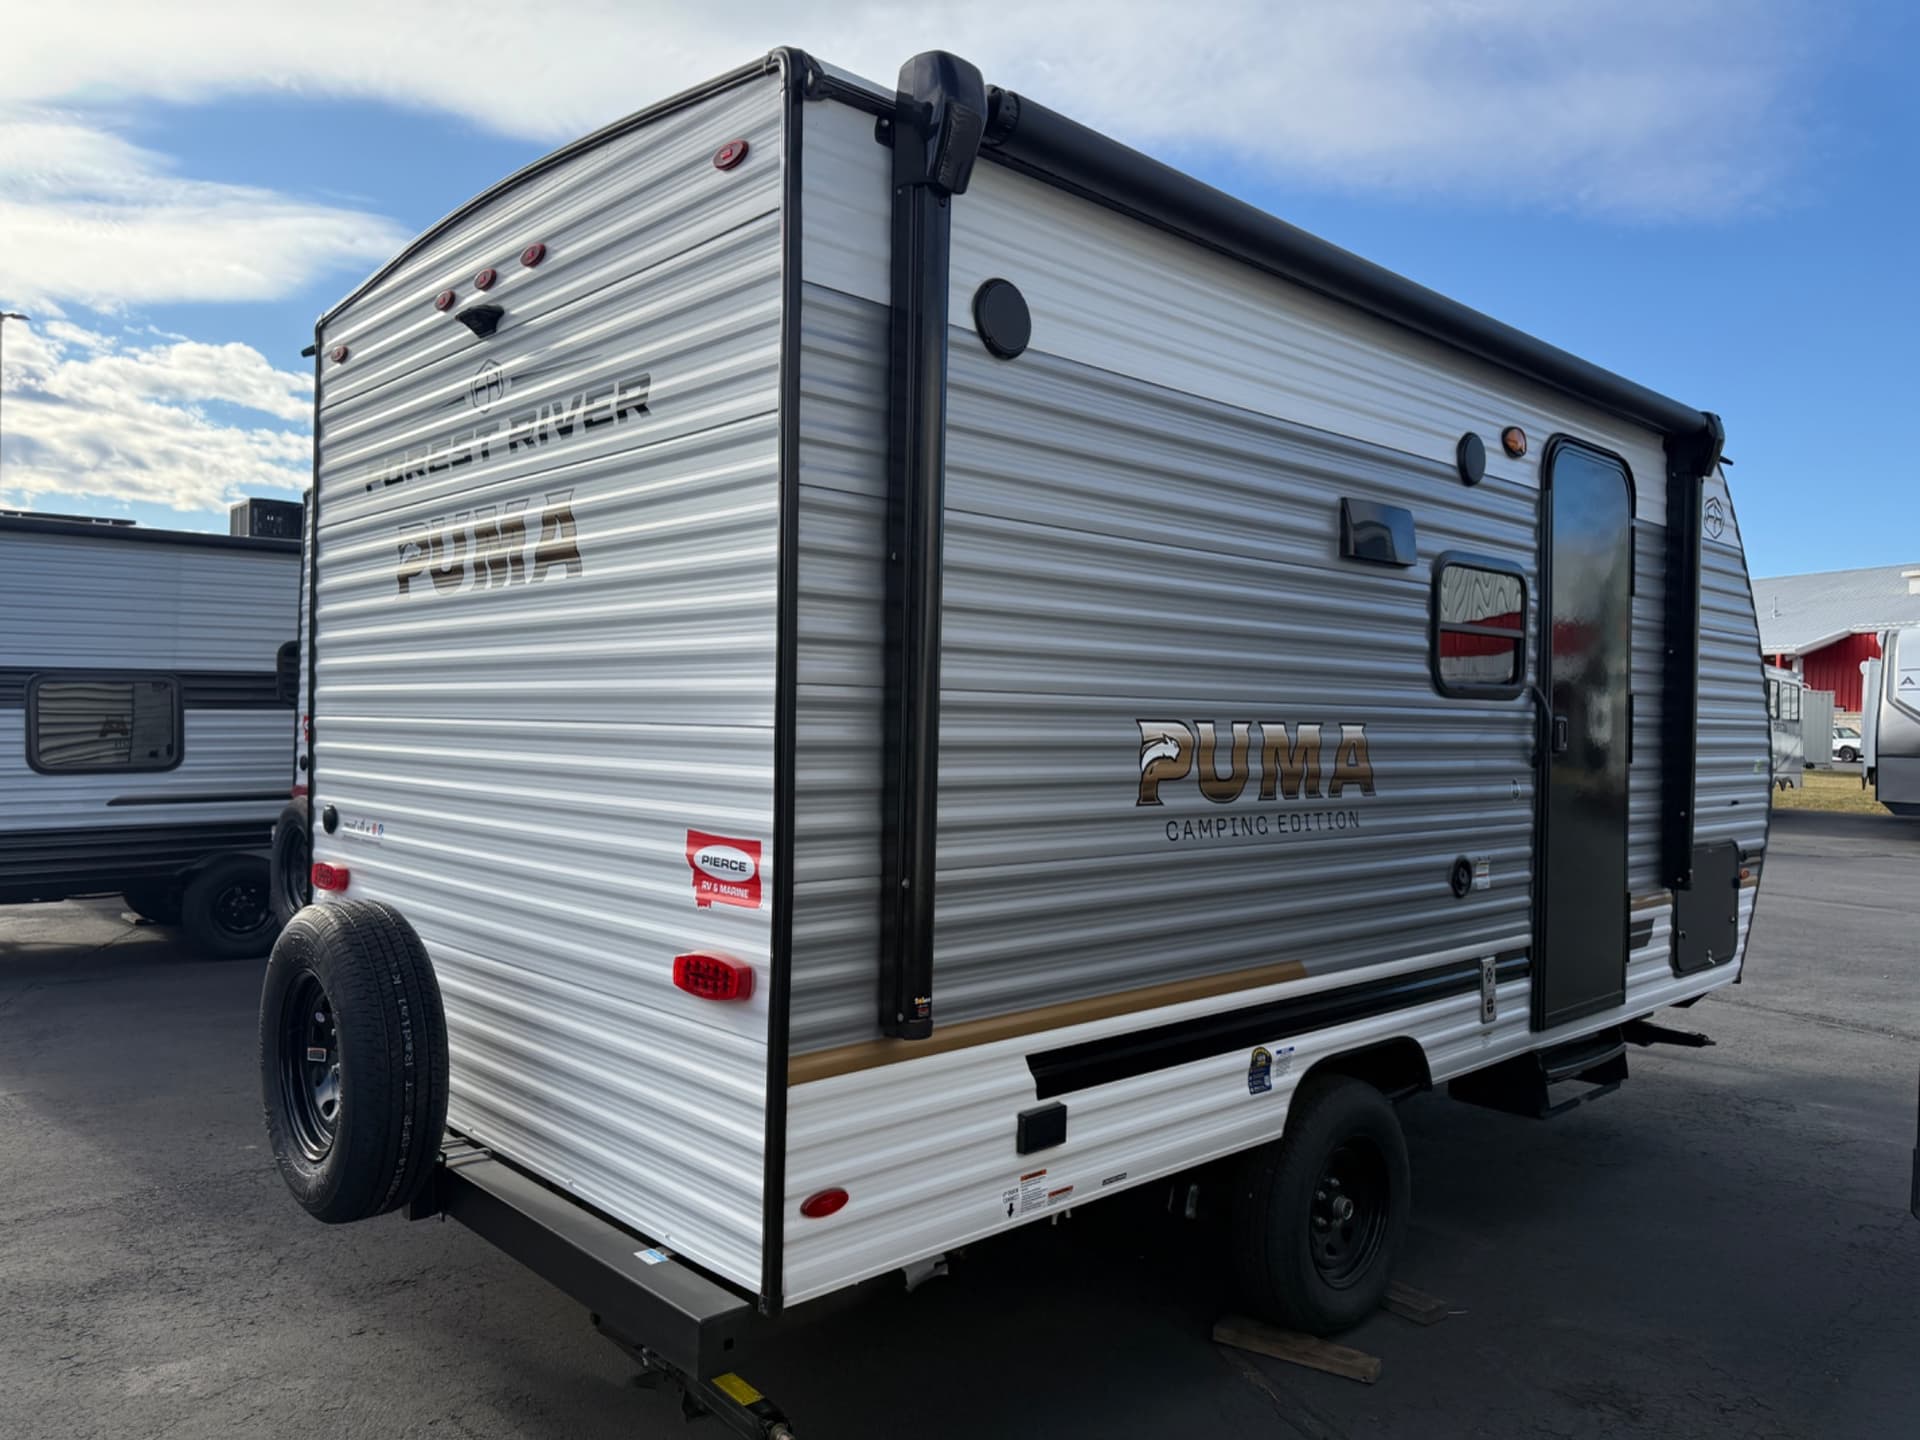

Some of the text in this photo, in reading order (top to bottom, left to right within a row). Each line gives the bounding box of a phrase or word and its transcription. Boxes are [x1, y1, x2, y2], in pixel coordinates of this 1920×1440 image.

[366, 373, 651, 492] FOREST RIVER
[397, 488, 583, 599] PUMA
[1136, 719, 1376, 806] PUMA
[1165, 810, 1361, 842] CAMPING EDITION
[701, 855, 747, 872] PIERCE
[701, 880, 712, 891] RV
[720, 884, 749, 898] MARINE
